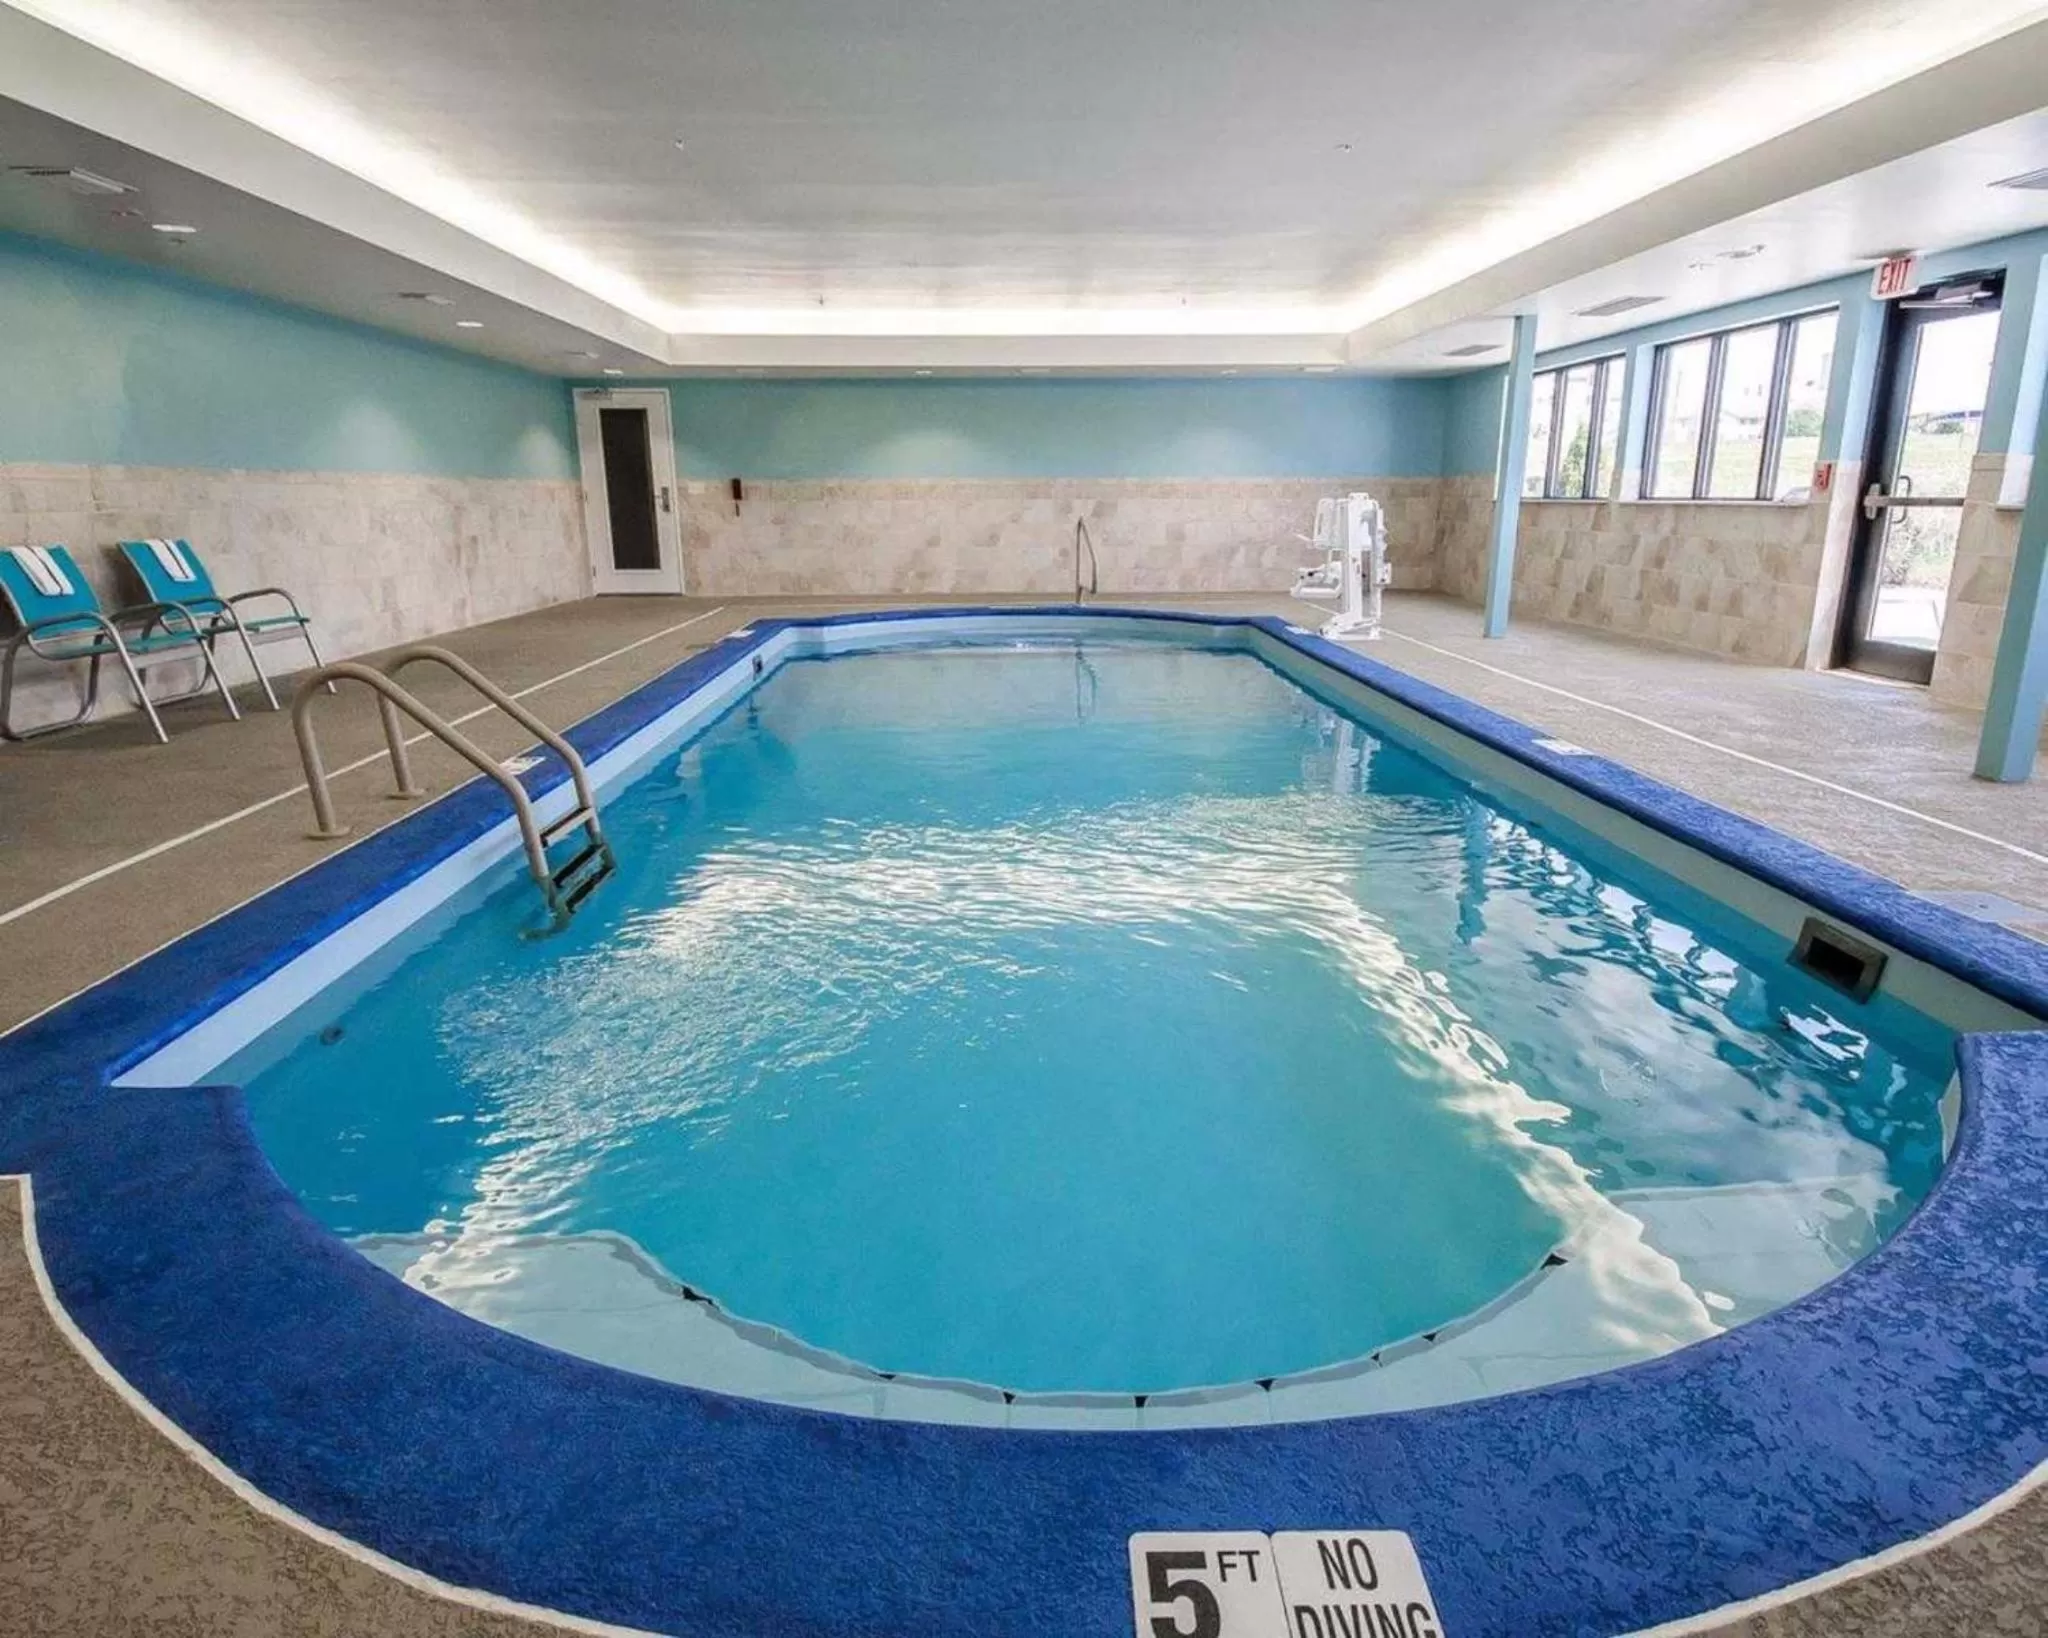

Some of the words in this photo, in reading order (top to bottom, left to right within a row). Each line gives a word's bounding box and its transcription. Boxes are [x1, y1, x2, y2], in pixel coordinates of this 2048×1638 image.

[1879, 258, 1911, 295] EXIT
[1318, 1538, 1379, 1591] NO
[1145, 1551, 1221, 1638] 5
[1217, 1550, 1260, 1582] FT
[1294, 1602, 1437, 1638] DIVING
